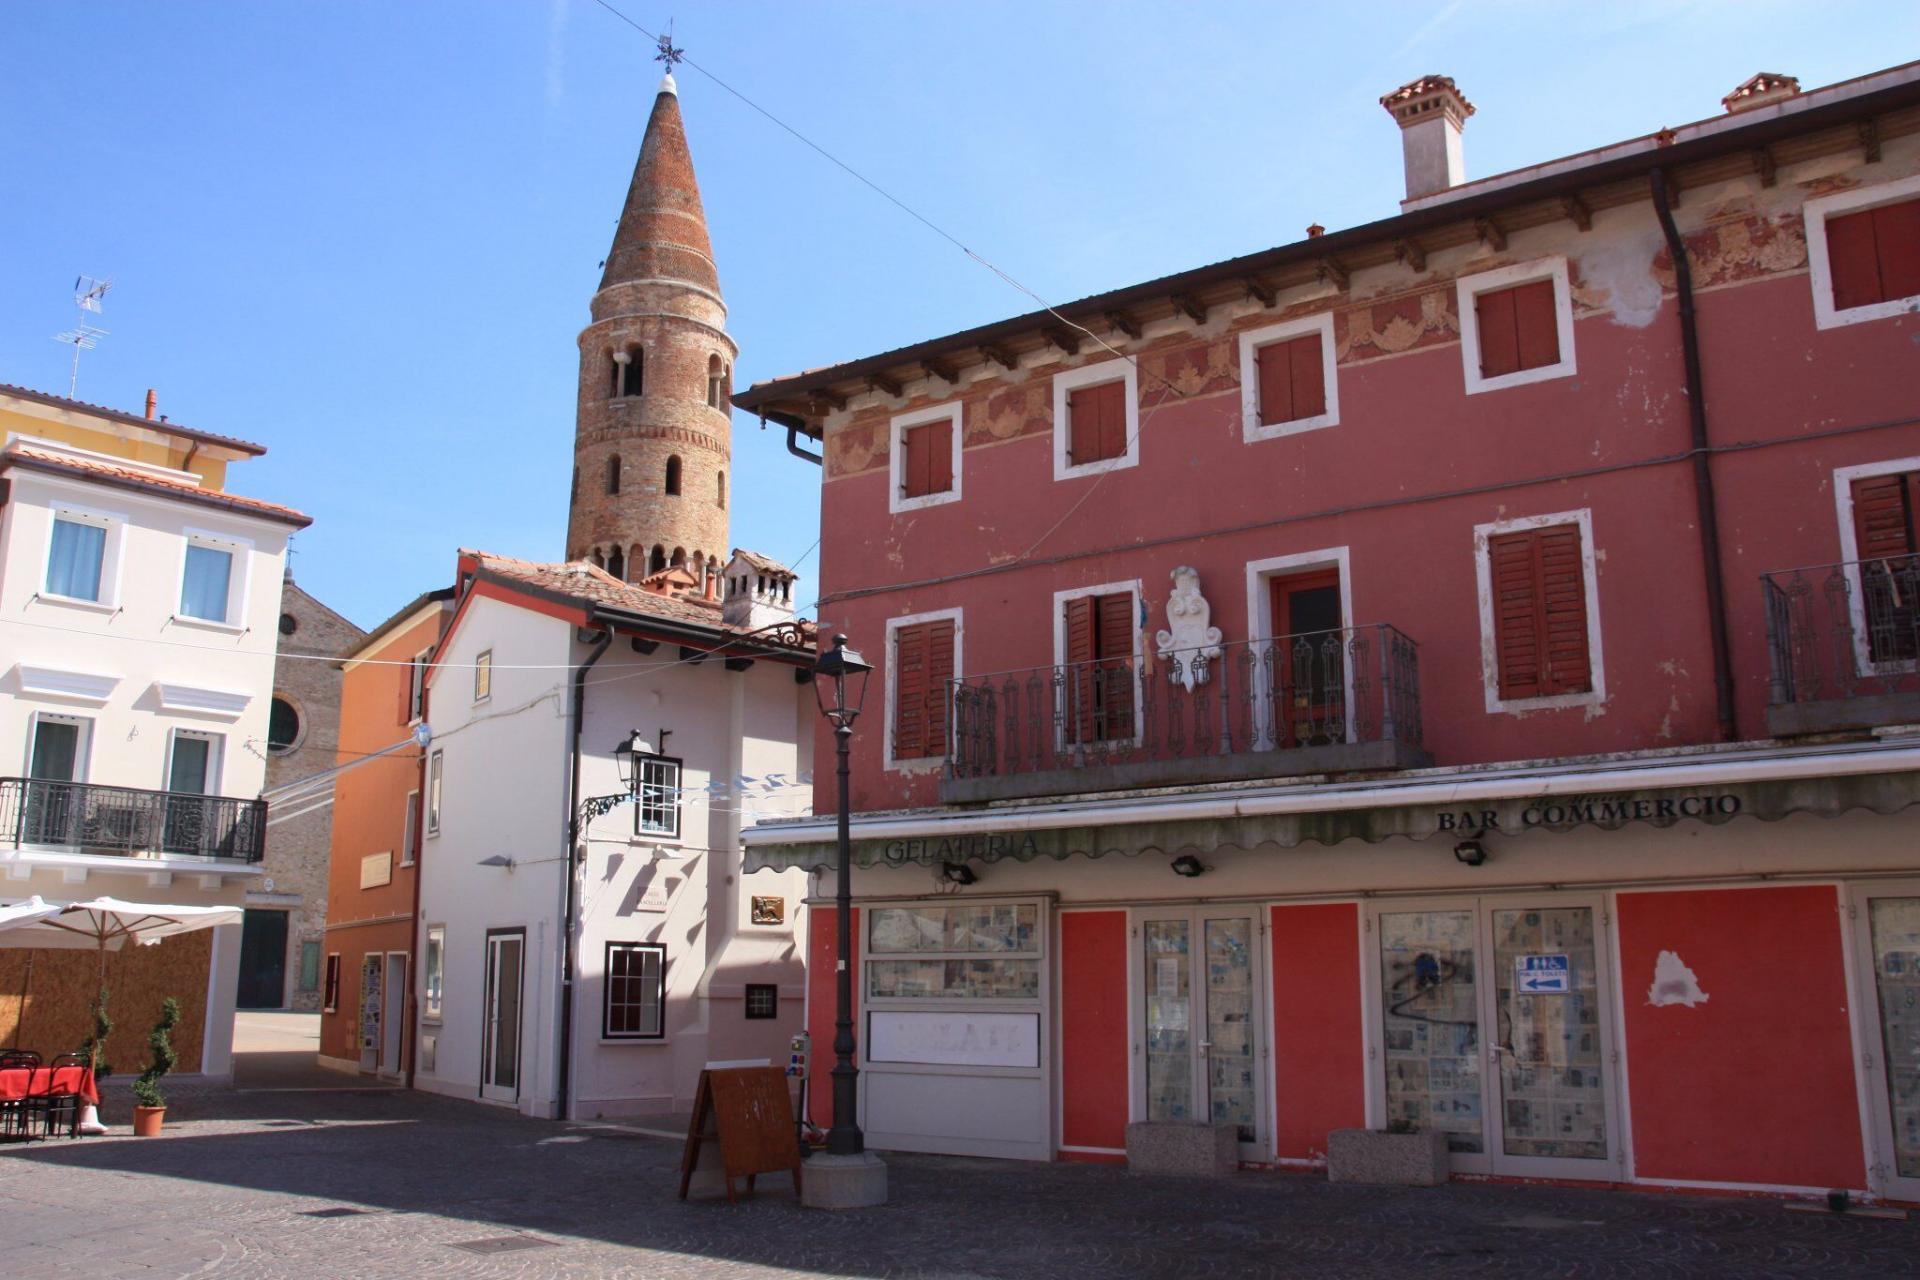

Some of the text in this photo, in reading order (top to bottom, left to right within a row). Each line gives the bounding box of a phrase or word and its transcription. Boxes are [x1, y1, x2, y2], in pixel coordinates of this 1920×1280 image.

[1437, 810, 1500, 832] BAR
[1521, 794, 1742, 826] COMMERCIO
[885, 834, 1038, 861] GELATERIA
